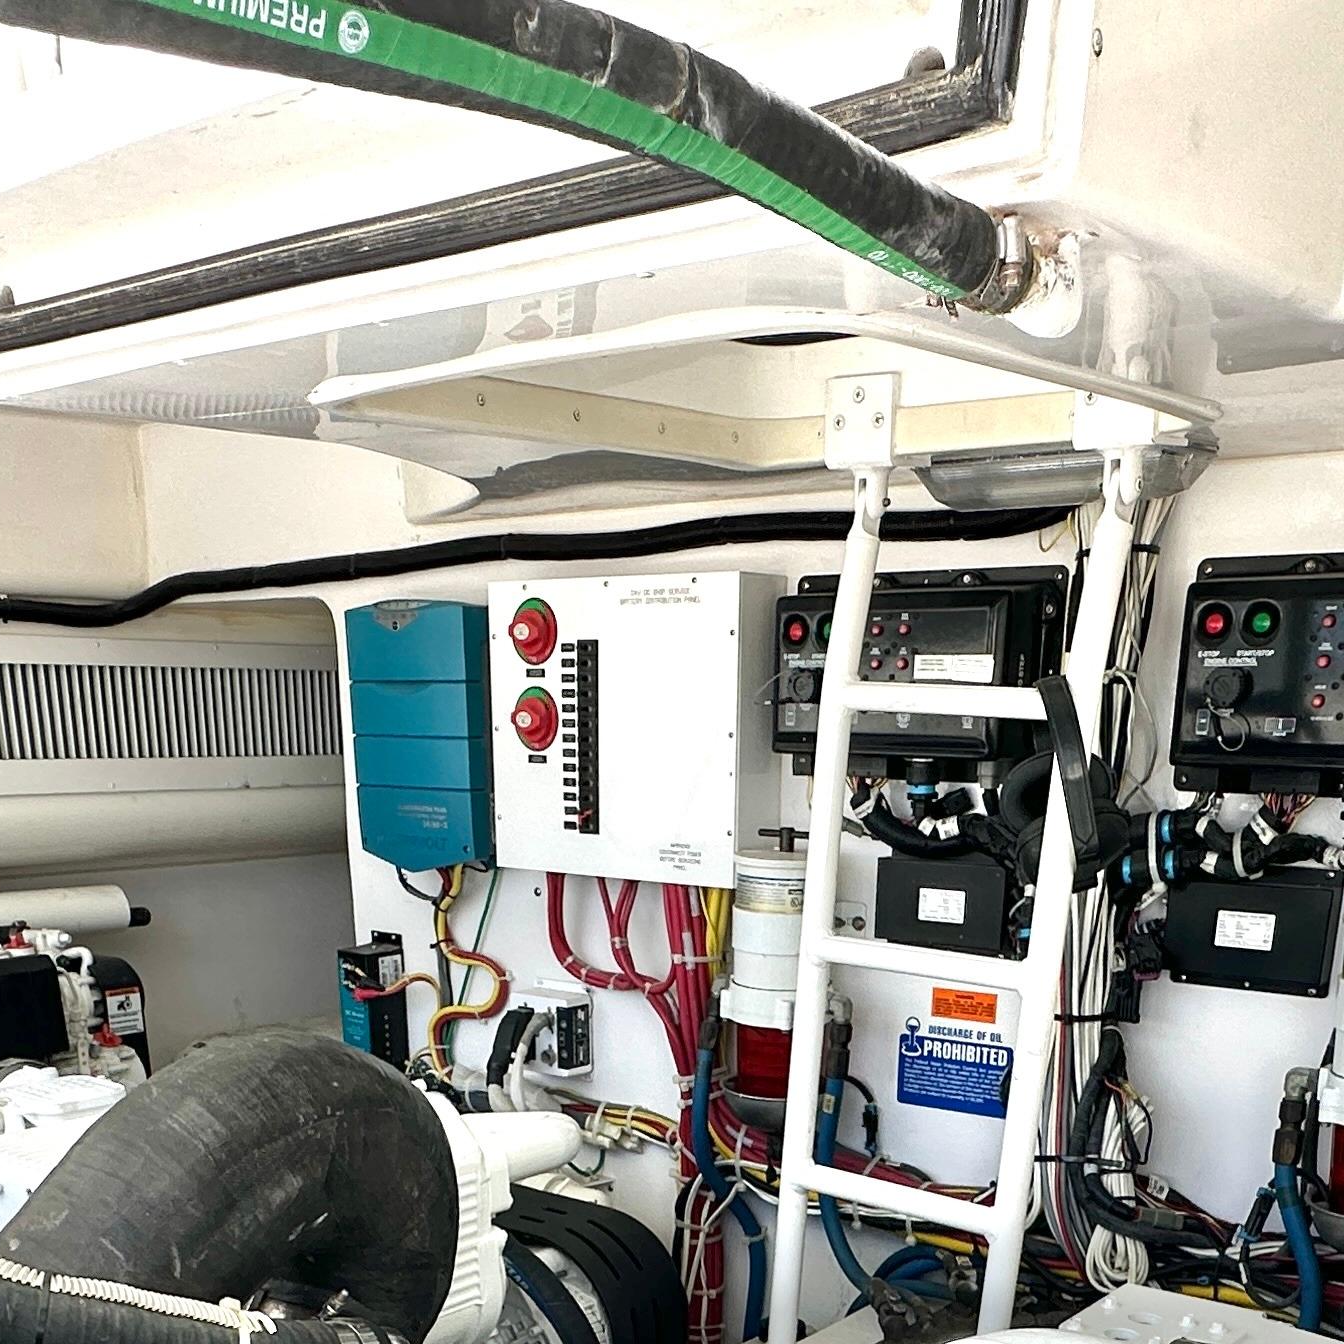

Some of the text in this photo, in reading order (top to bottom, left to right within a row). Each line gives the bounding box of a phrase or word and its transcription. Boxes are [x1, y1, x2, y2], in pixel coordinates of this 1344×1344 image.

[193, 0, 327, 38] PREMI
[927, 1025, 974, 1040] DISCHARGE
[976, 1030, 987, 1041] OF
[923, 1039, 1008, 1067] PROHIBITED
